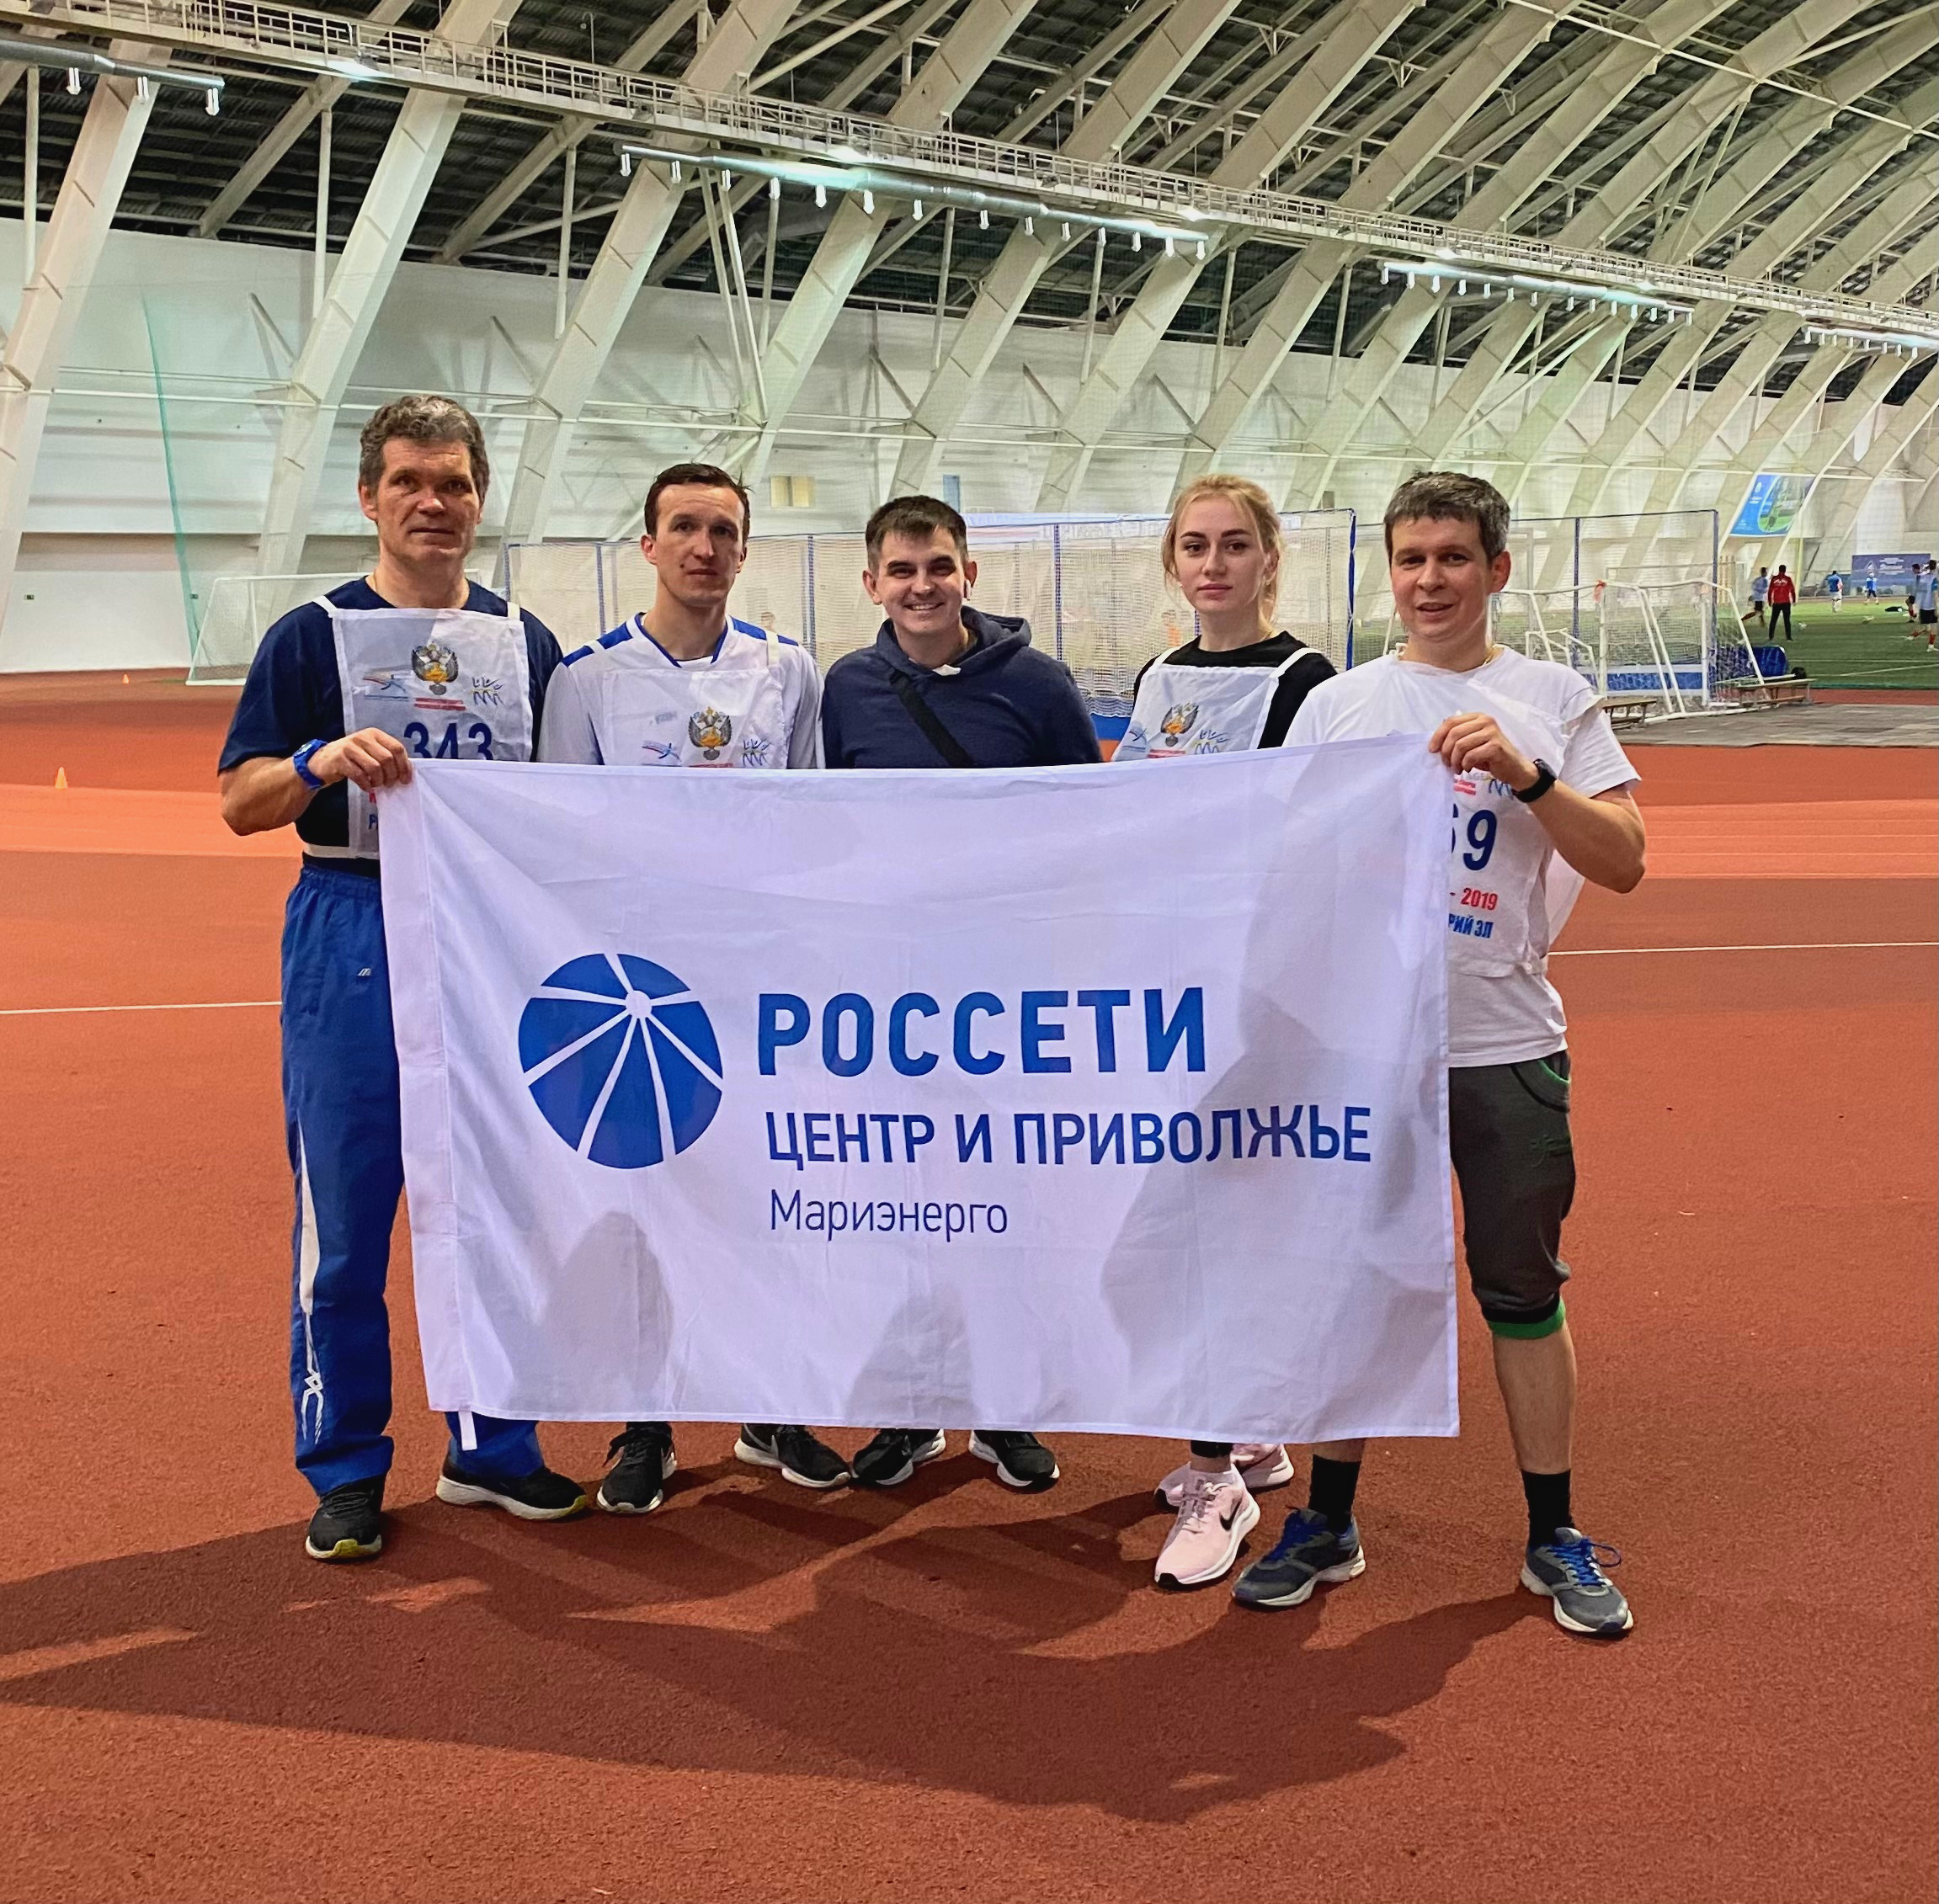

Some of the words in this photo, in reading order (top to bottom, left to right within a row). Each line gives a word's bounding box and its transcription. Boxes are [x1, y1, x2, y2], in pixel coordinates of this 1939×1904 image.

[403, 721, 493, 760] 343
[1452, 803, 1498, 870] 9
[1460, 887, 1499, 911] 2019
[758, 987, 1206, 1077] РОССЕТИ
[765, 1111, 935, 1171] ЦЕНТР
[955, 1114, 993, 1163] И
[1015, 1104, 1371, 1165] ПРИВОЛЖЬЕ
[770, 1189, 1009, 1243] Мариэнерго
